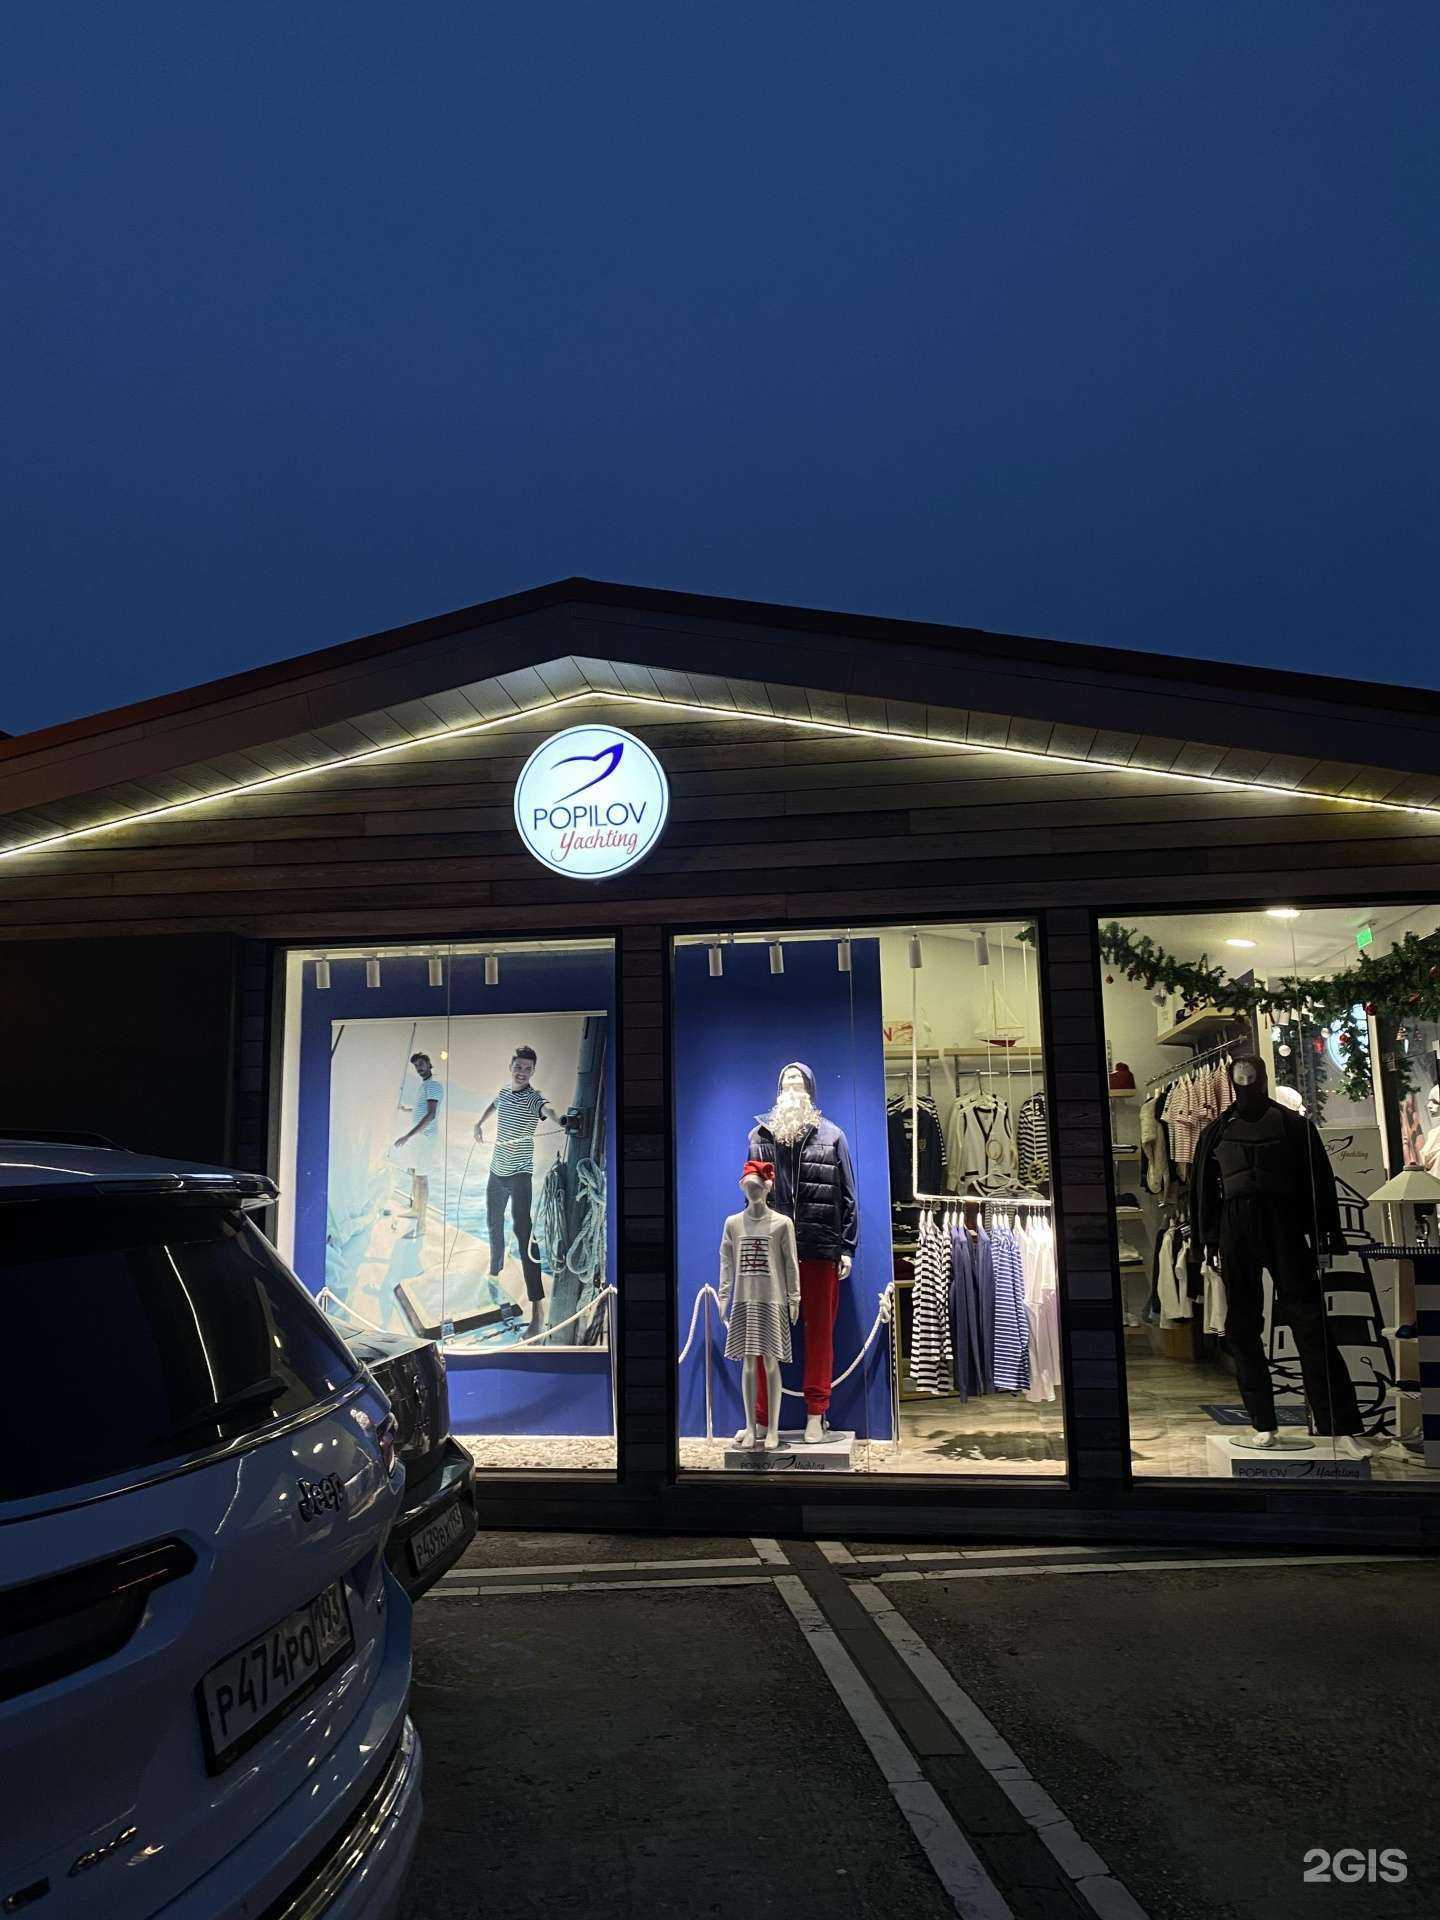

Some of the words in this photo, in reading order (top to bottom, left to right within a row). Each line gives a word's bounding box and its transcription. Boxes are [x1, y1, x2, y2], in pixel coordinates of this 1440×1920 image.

[533, 801, 647, 831] POPILOV
[551, 829, 638, 863] Yachting
[1239, 1467, 1288, 1478] POPILOV
[297, 1472, 343, 1522] Jeep
